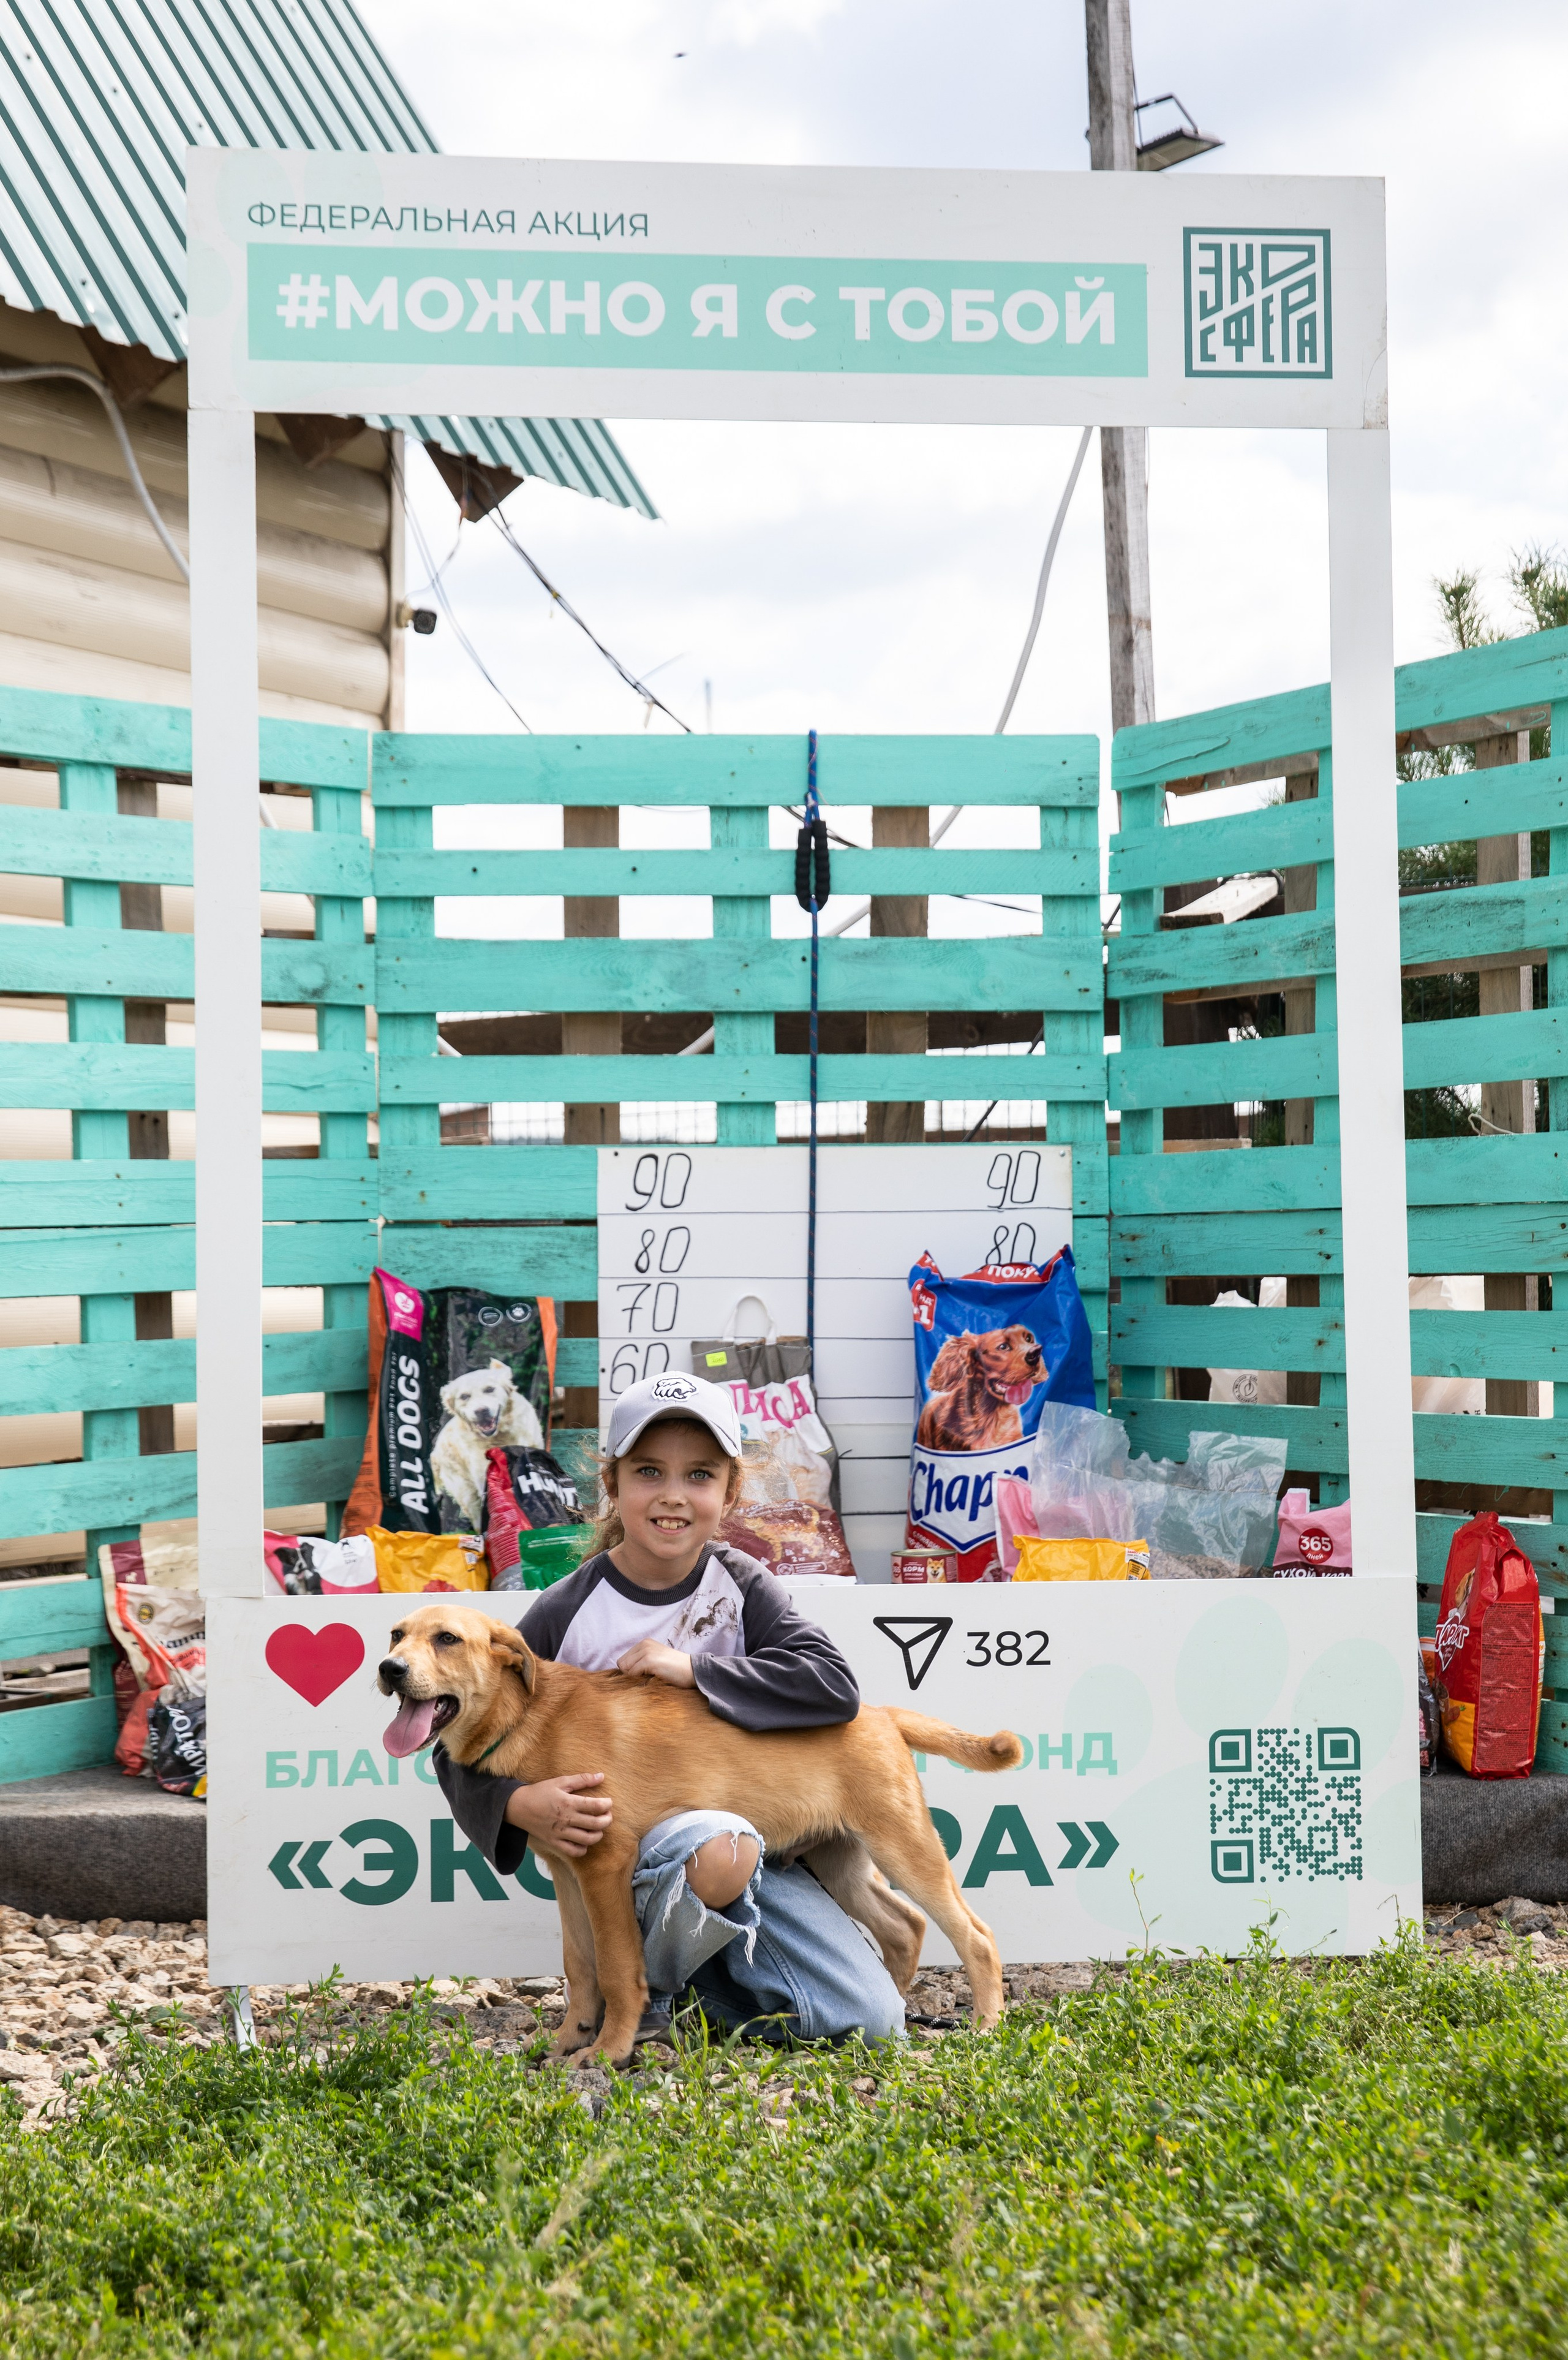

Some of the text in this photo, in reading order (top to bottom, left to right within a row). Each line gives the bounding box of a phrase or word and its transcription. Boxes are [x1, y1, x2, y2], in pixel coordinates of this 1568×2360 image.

[247, 202, 649, 240] ФЕДЕРАЛЬНАЯ АКЦИЯ
[276, 273, 1115, 344] #МОЖНО Я С ТОБОЙ
[625, 1152, 692, 1211] 90
[987, 1151, 1041, 1209] 90
[635, 1226, 690, 1273] 80
[986, 1222, 1036, 1265] 80
[617, 1282, 679, 1333] 70
[610, 1342, 669, 1394] 60
[396, 1355, 423, 1450] DOGS
[388, 1411, 397, 1450] premium
[388, 1453, 397, 1498] Complete
[400, 1456, 429, 1515] ALL
[1300, 1535, 1332, 1552] 365
[965, 1630, 1051, 1667] 382
